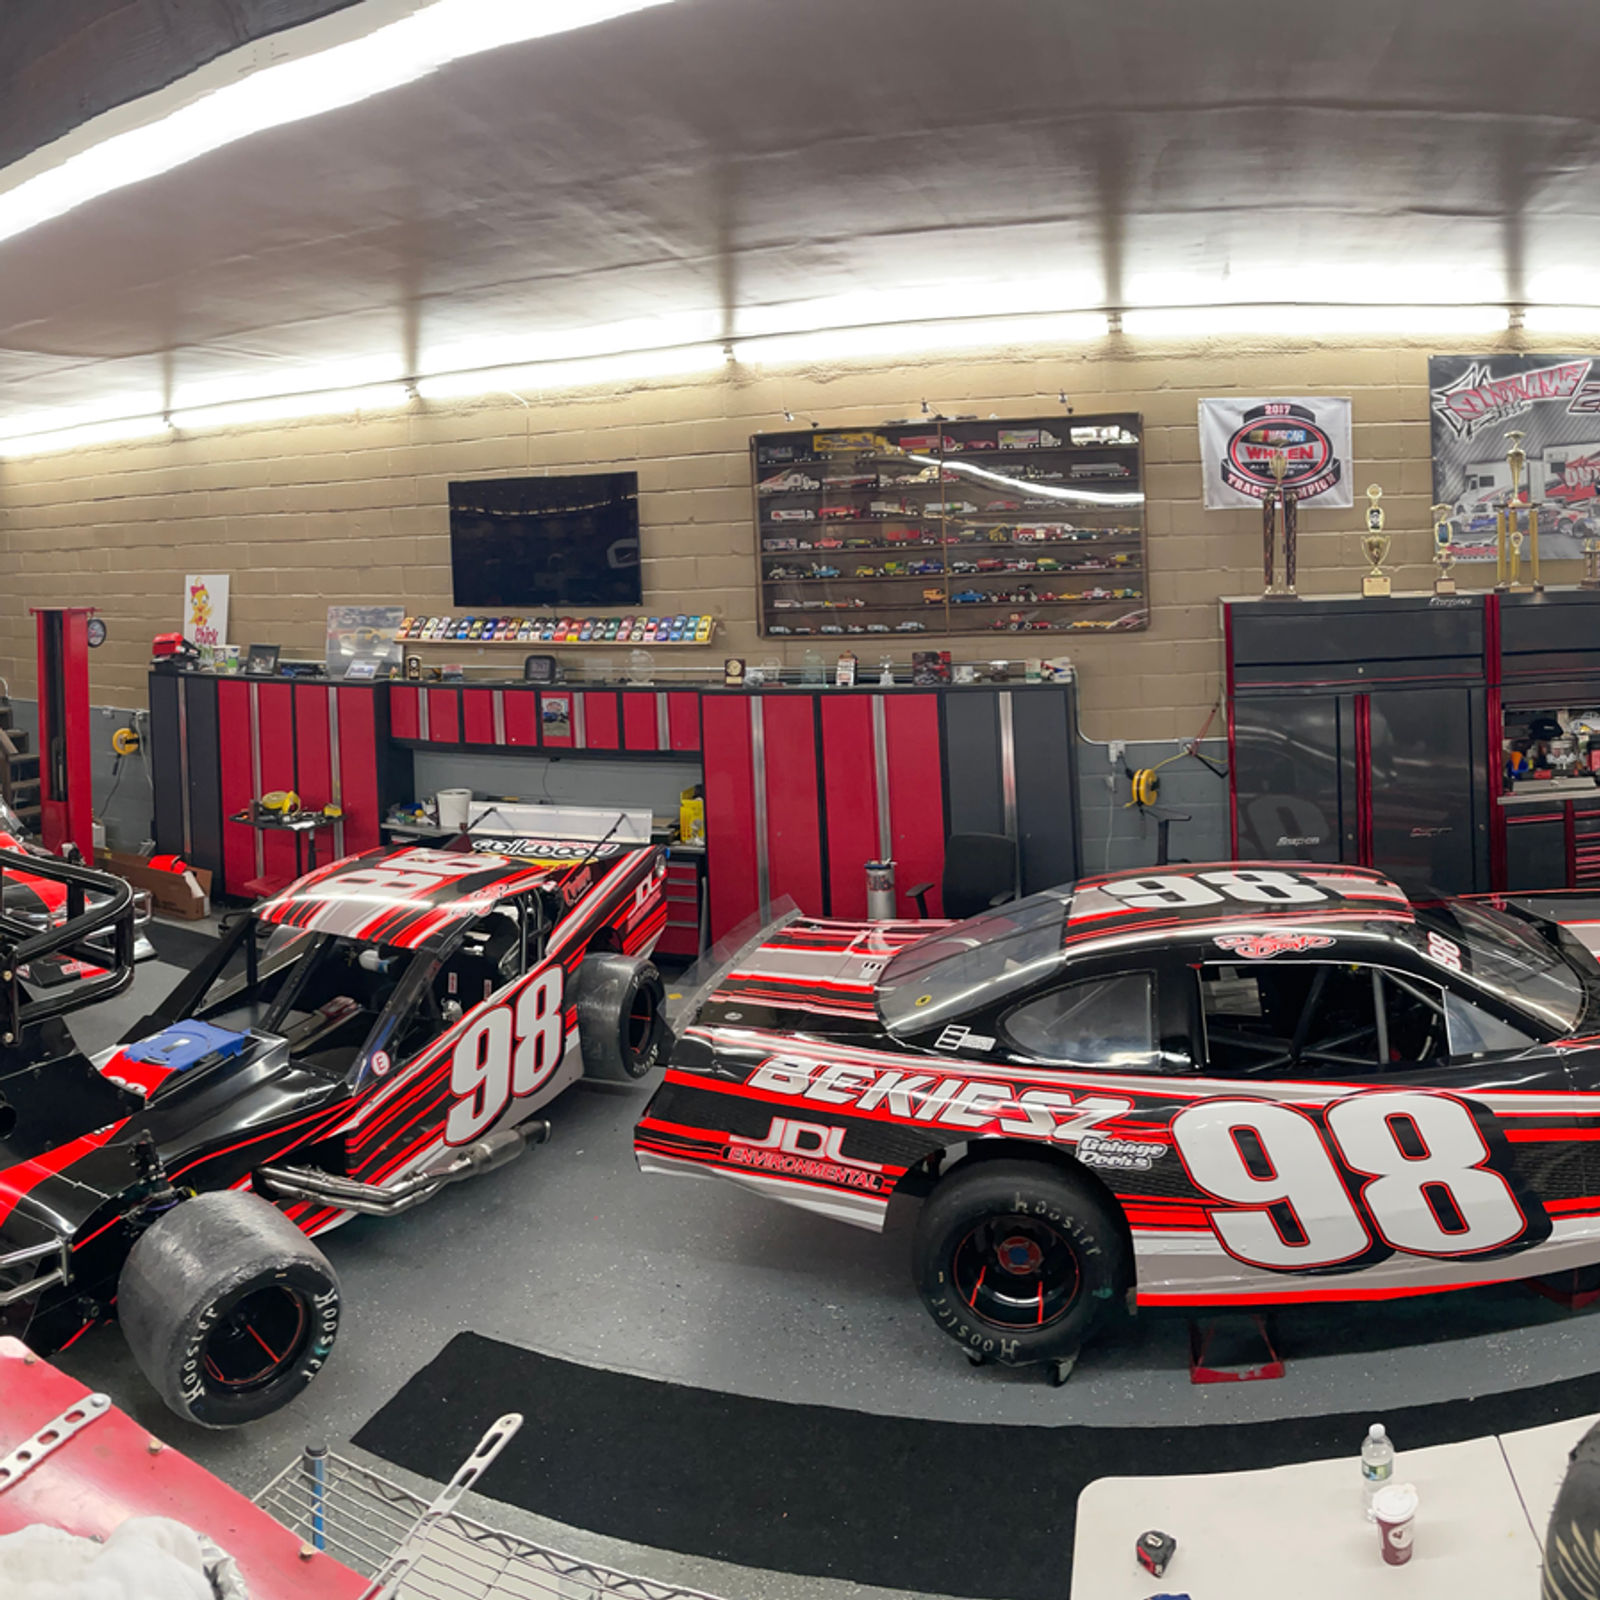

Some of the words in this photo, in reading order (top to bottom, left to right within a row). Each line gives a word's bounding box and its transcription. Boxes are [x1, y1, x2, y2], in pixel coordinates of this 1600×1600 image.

[1264, 404, 1291, 415] 2017
[1101, 871, 1328, 908] 98
[443, 964, 564, 1147] 98
[747, 1056, 1134, 1140] BEKIESZ
[728, 1116, 883, 1172] JDL
[728, 1147, 880, 1190] ENVIRONMENTAL
[1171, 1094, 1528, 1270] 98
